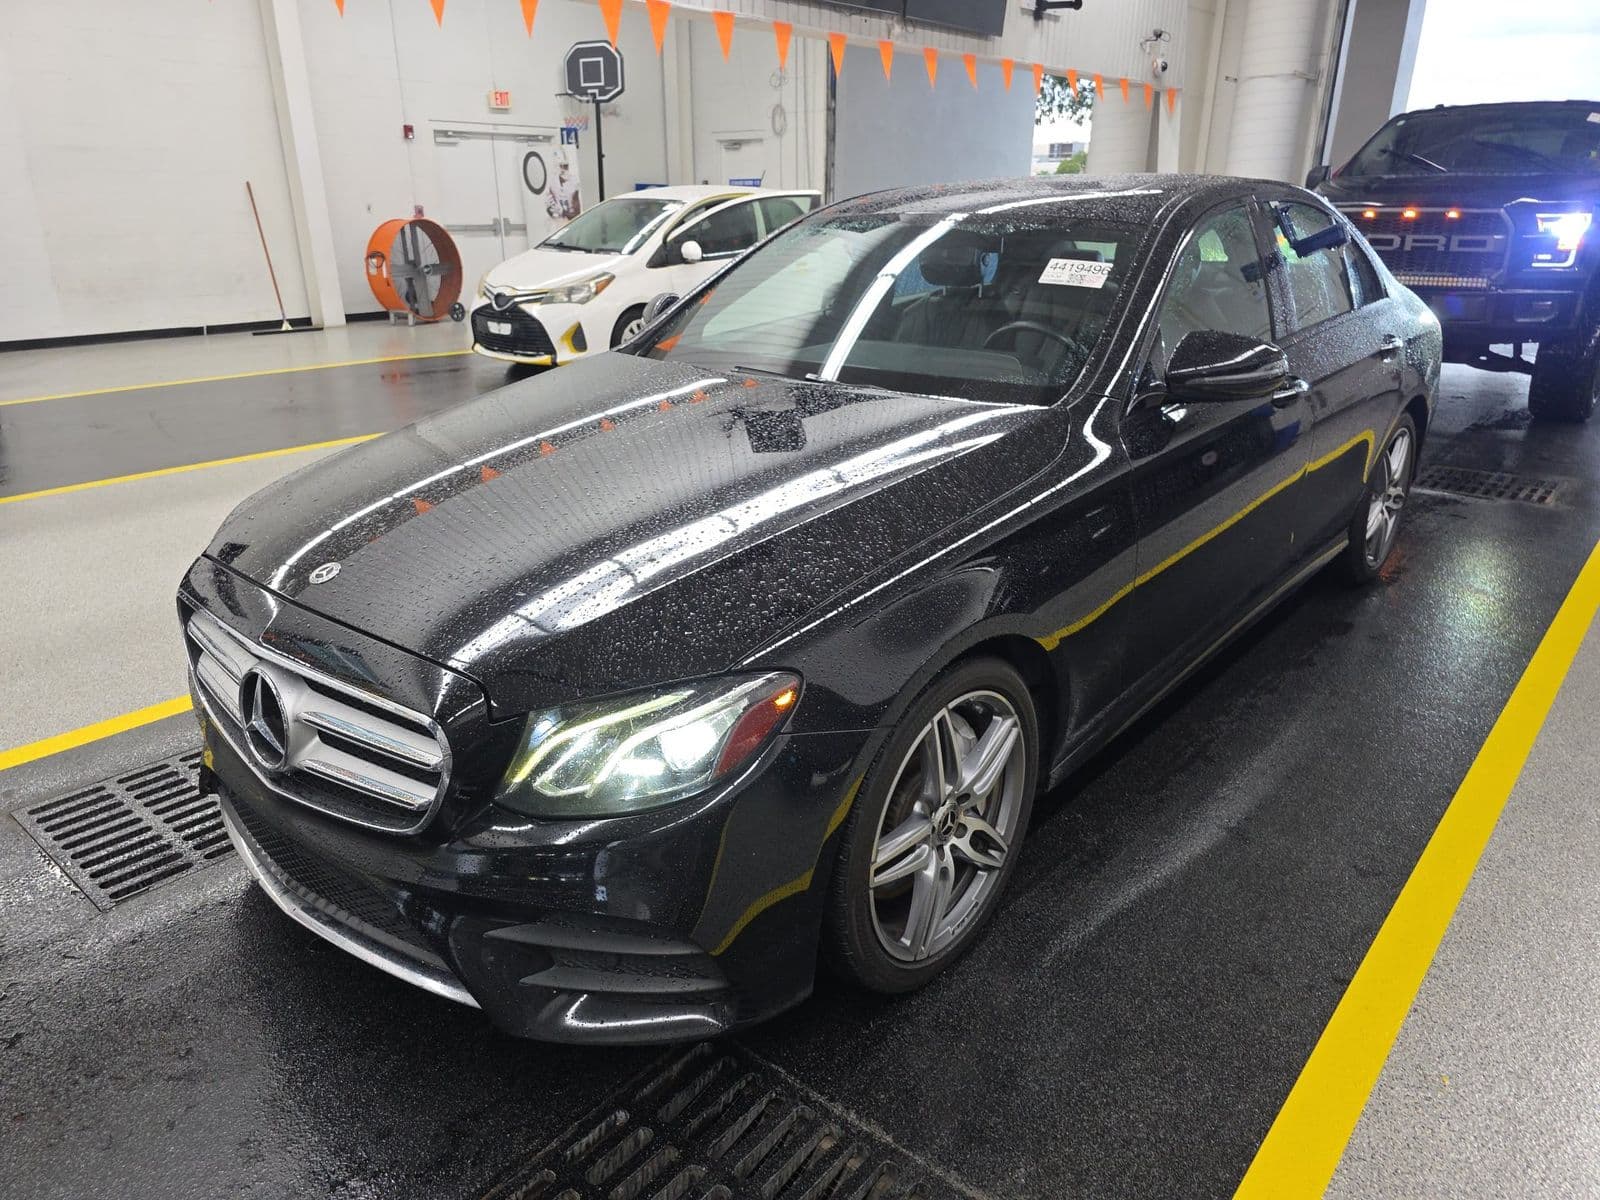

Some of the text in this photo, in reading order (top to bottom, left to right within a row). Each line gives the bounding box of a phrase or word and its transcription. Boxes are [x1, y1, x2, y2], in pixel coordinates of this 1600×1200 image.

[494, 91, 509, 106] EXIT
[562, 129, 577, 143] 14
[1365, 233, 1498, 251] ORD
